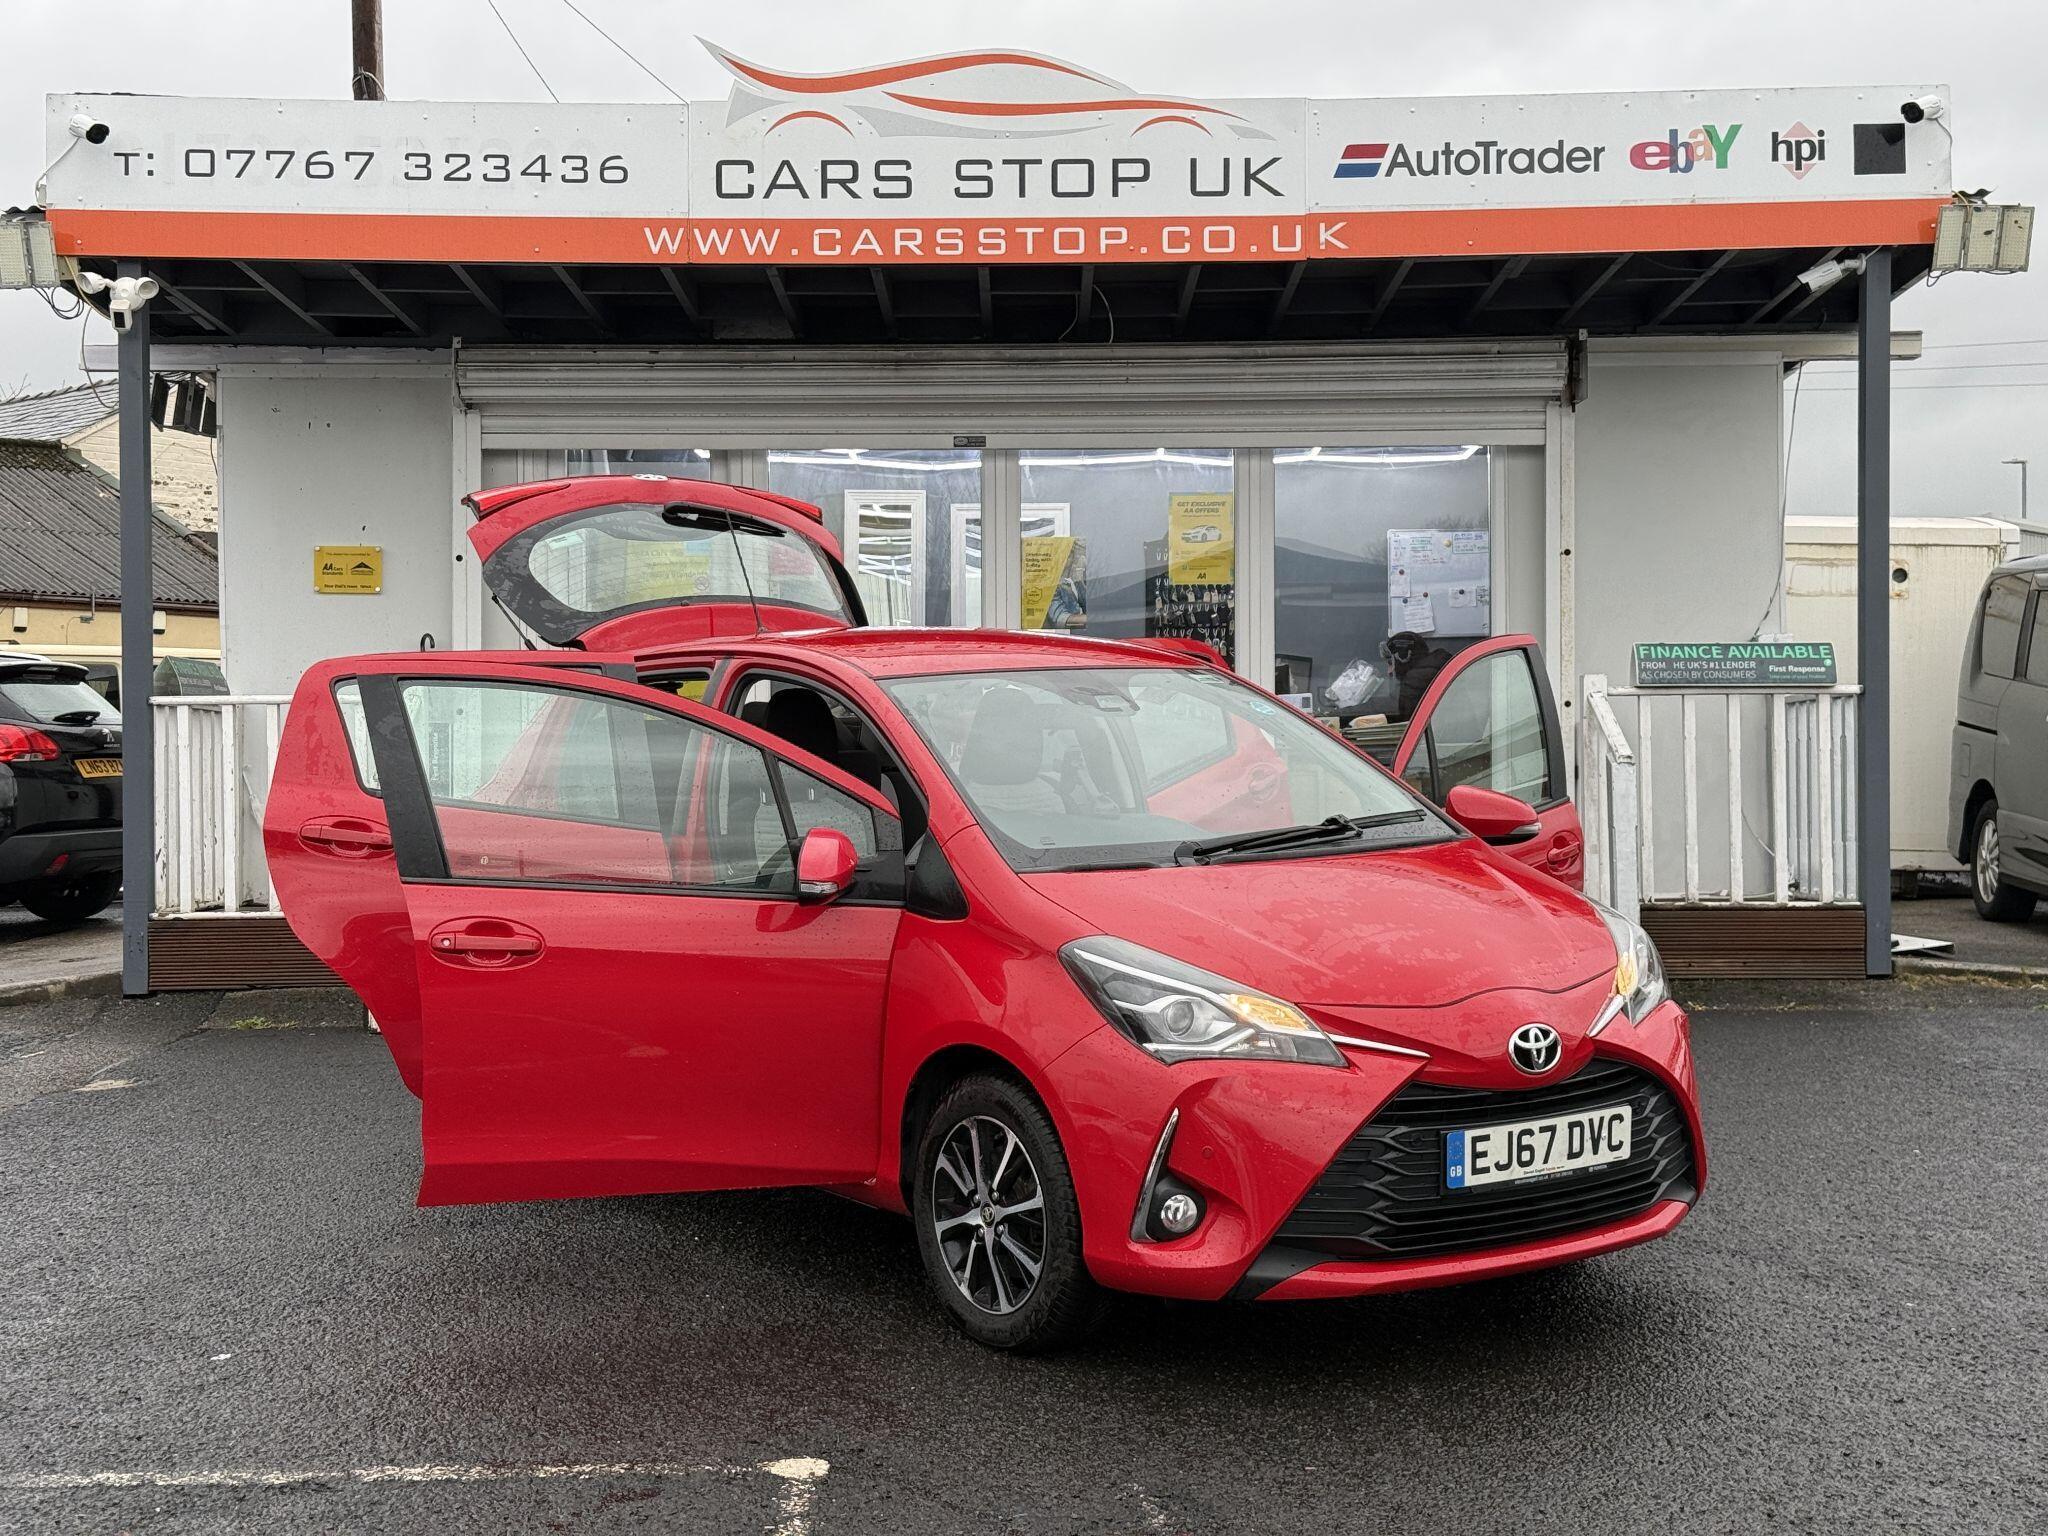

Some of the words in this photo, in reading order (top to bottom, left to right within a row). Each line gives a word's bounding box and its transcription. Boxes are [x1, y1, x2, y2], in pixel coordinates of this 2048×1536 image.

[1771, 129, 1826, 171] hpi
[1385, 139, 1606, 178] AutoTrader
[114, 153, 154, 177] T:
[184, 149, 375, 181] 07767
[404, 152, 629, 184] 323436
[715, 159, 913, 200] CARS
[954, 158, 1151, 199] STOP
[1189, 157, 1284, 197] UK
[643, 221, 1349, 257] WWW.CARSSTOP.CO.UK
[322, 563, 333, 571] AA
[1197, 572, 1207, 580] AA
[1639, 645, 1724, 659] FINANCE
[1728, 645, 1832, 659] AVAILABLE
[1641, 661, 1666, 669] FROM
[1673, 661, 1686, 669] HE
[1687, 661, 1709, 669] UK'S
[1709, 661, 1719, 669] #1
[1721, 661, 1757, 669] LENDER
[1768, 664, 1787, 673] First
[1788, 664, 1826, 674] Response
[1653, 670, 1690, 679] CHOSEN
[1691, 670, 1702, 678] BY
[1703, 670, 1757, 678] CONSUMERS
[79, 759, 109, 775] LN63
[106, 759, 123, 774] BZ
[1470, 1124, 1558, 1176] EJ67
[1566, 1113, 1625, 1161] DVC
[1450, 1166, 1463, 1178] GB
